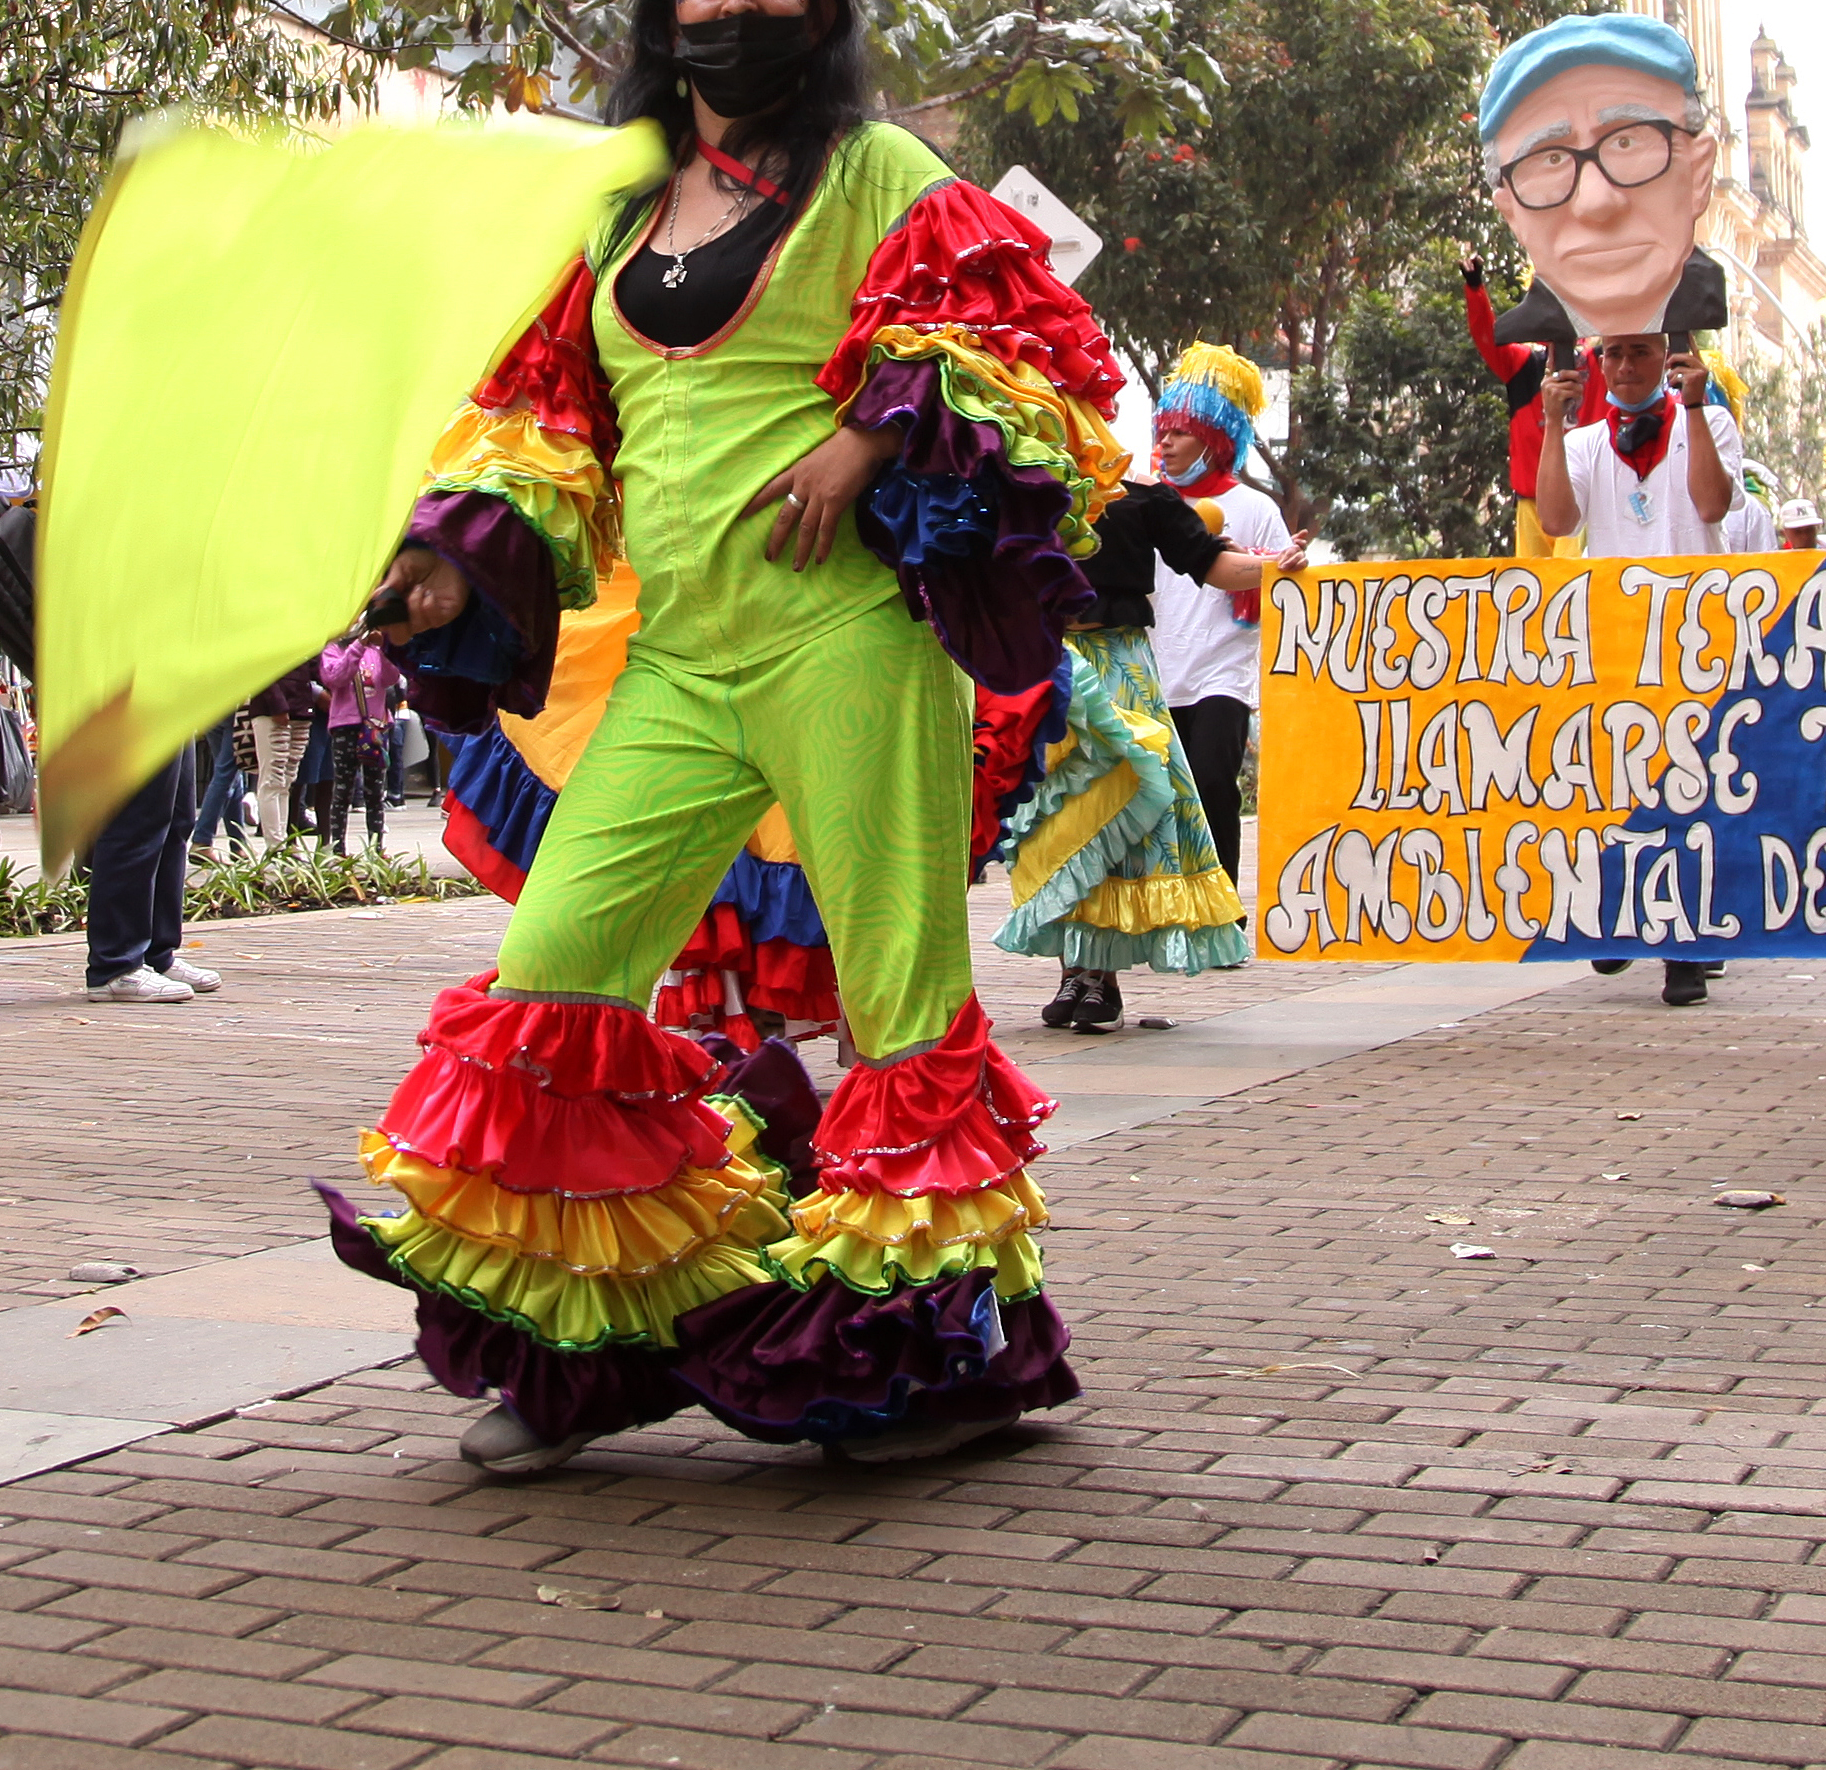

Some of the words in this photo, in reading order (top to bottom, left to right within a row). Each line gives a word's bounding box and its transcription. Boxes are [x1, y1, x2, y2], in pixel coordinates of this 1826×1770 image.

[1270, 567, 1596, 694] NUESTRA
[1349, 697, 1764, 817] LLAMARSE
[1265, 820, 1742, 953] AMBIENTAL
